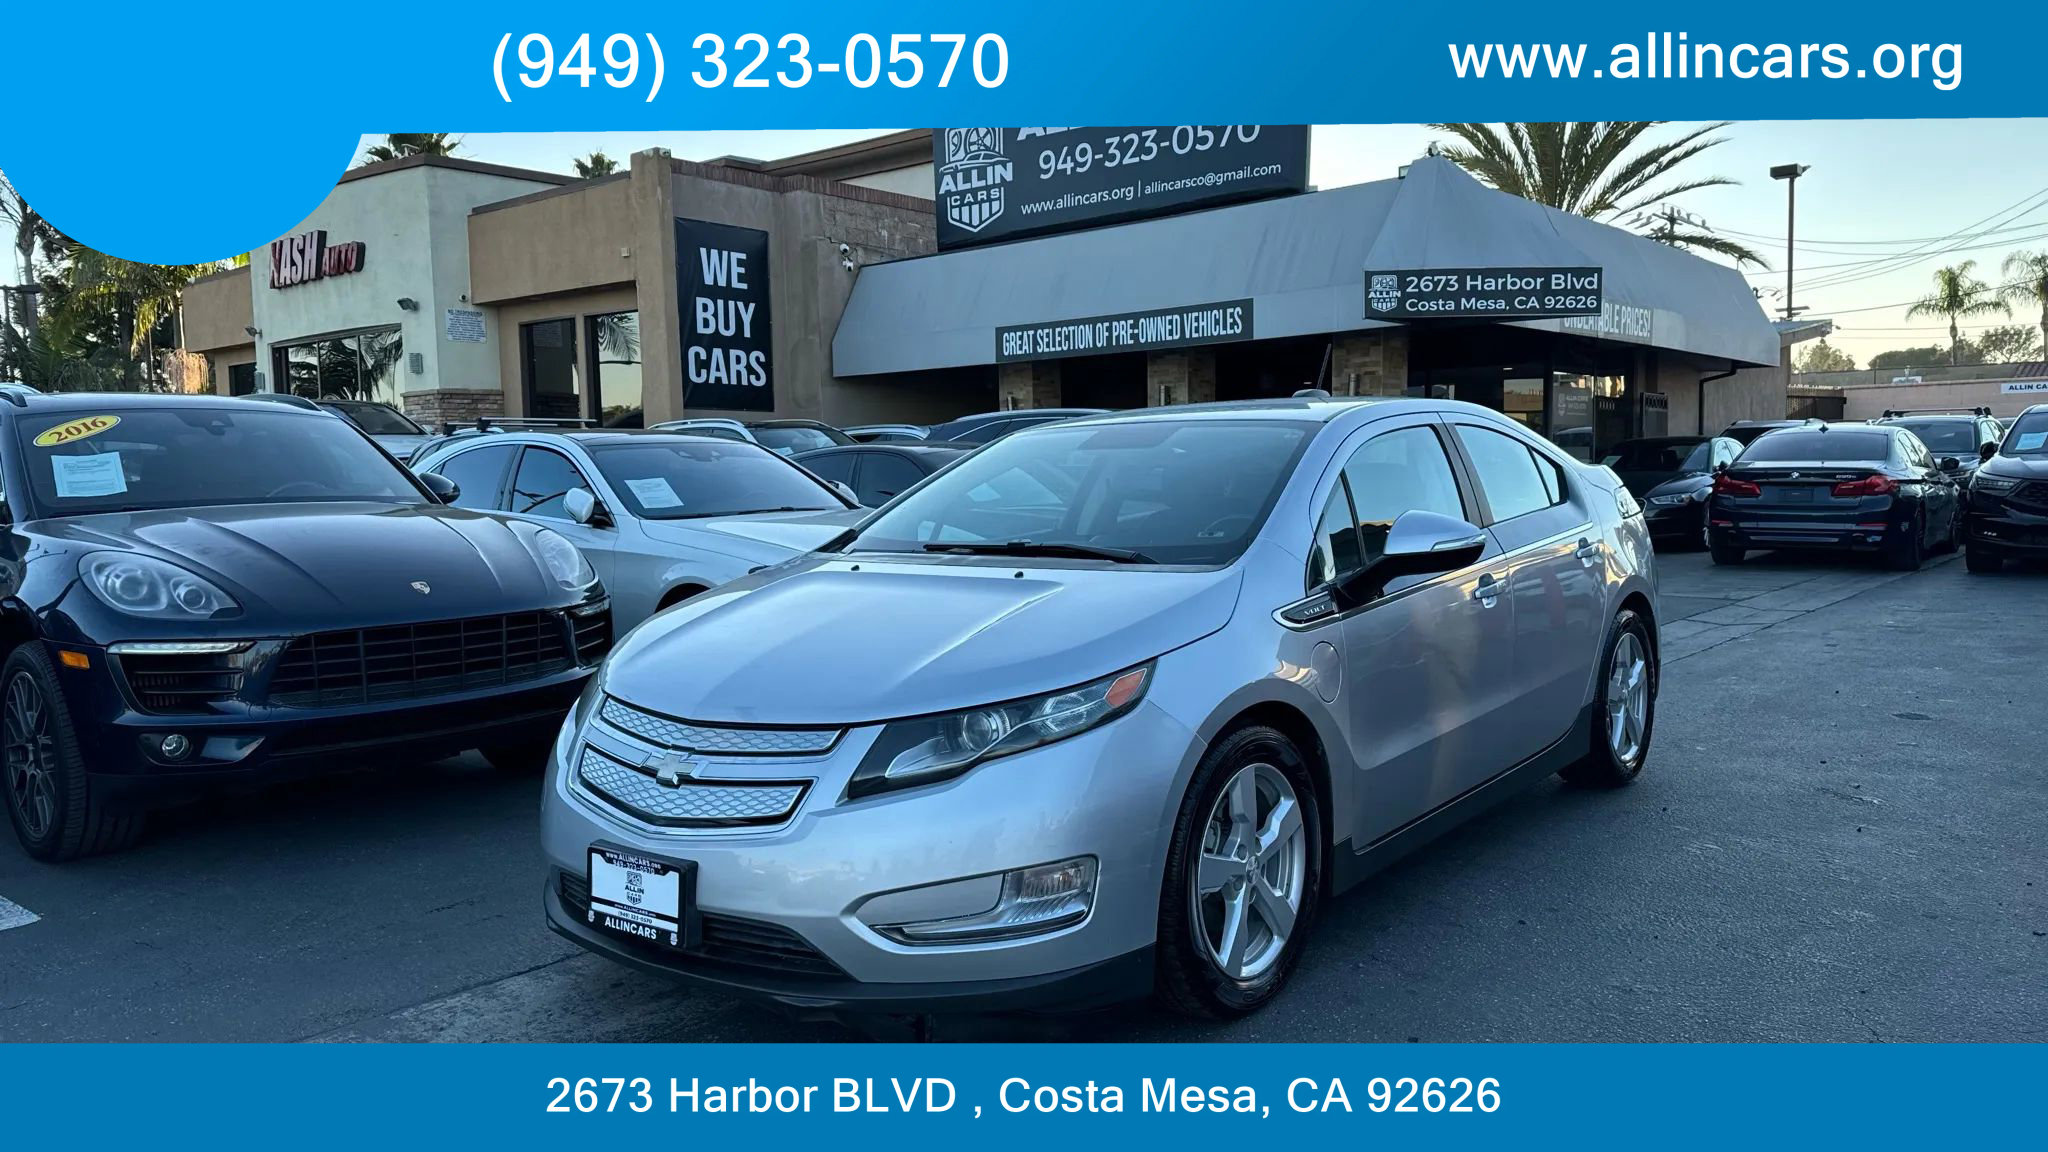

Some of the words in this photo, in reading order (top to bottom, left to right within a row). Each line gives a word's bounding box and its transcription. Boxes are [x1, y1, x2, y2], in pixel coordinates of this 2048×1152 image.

[1039, 125, 1261, 180] 949-323-0570
[939, 161, 1014, 195] ALLIN
[1021, 184, 1135, 216] www.allincars.org
[1145, 163, 1282, 196] allincarsco@gmail.com
[951, 188, 1001, 206] CARS
[270, 230, 321, 288] KASH
[322, 241, 361, 276] AUTO
[699, 247, 748, 290] WE
[1368, 290, 1401, 299] ALLIN
[1405, 275, 1459, 293] 2673
[1466, 274, 1543, 291] Harbor
[1551, 273, 1599, 290] Blvd
[695, 297, 756, 338] BUY
[1405, 298, 1456, 312] Costa
[1514, 296, 1540, 310] CA
[1544, 295, 1598, 309] 92626
[1002, 329, 1035, 356] GREAT
[1036, 324, 1093, 353] SELECTION
[1096, 322, 1110, 348] OF
[1112, 314, 1181, 346] PRE-OWNED
[1183, 306, 1243, 339] VEHICLES
[1621, 306, 1651, 338] PRICES!
[687, 346, 767, 387] CARS
[48, 417, 108, 442] 2016
[1305, 604, 1325, 616] VOLT
[624, 884, 645, 895] ALLIN
[604, 915, 657, 940] ALLINCARS
